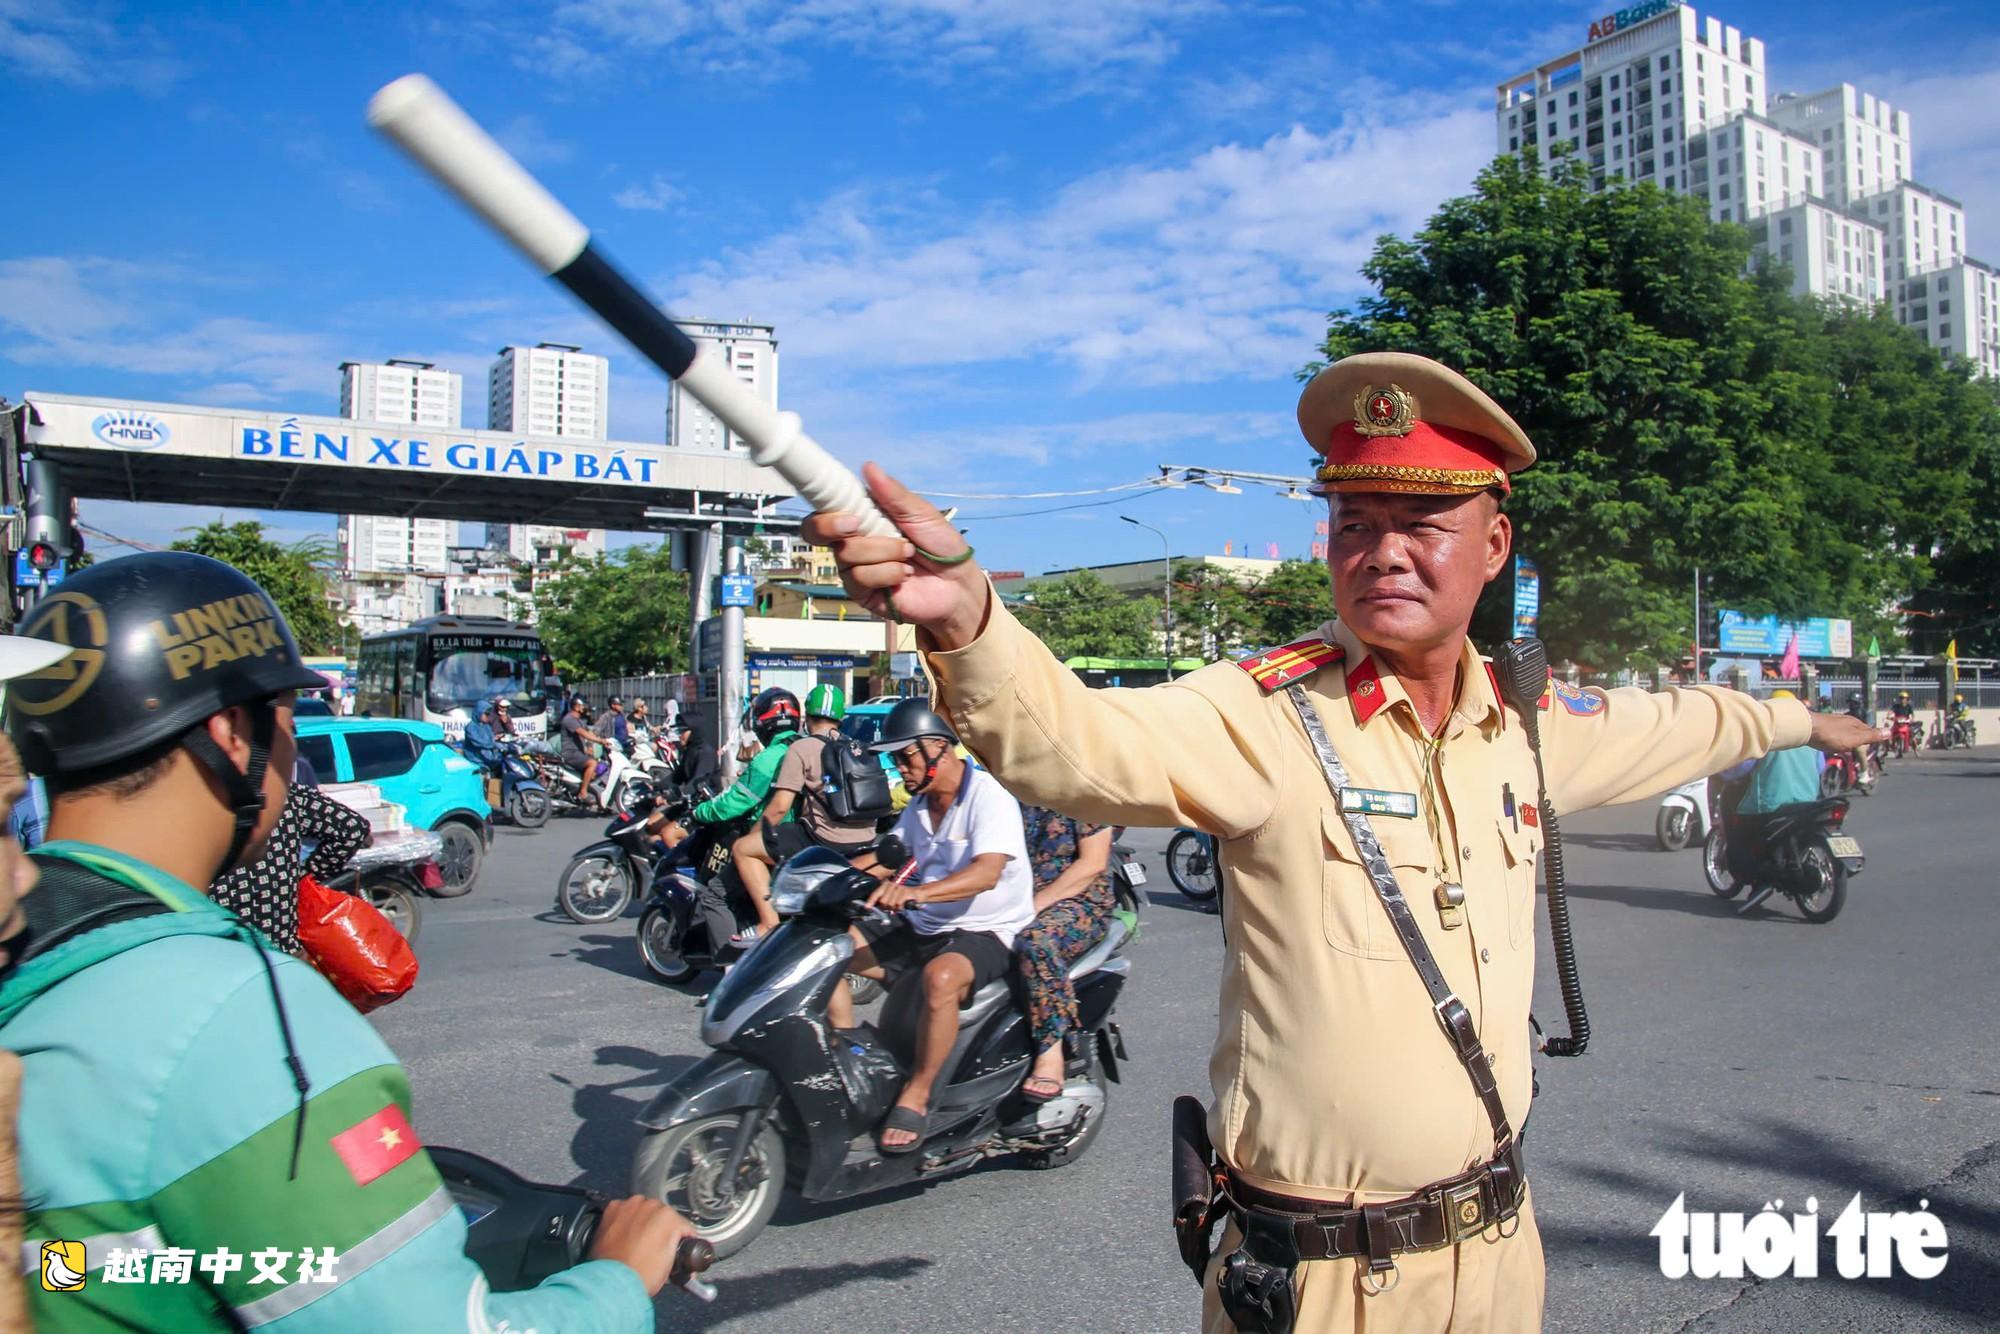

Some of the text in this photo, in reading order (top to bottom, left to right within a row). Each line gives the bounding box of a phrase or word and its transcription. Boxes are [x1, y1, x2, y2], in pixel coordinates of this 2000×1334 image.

[109, 427, 154, 440] HNB
[241, 417, 658, 483] BẾN XE GIÁP BÁT
[733, 585, 743, 597] 2
[148, 592, 273, 650] LINKIN
[163, 618, 285, 681] PARK
